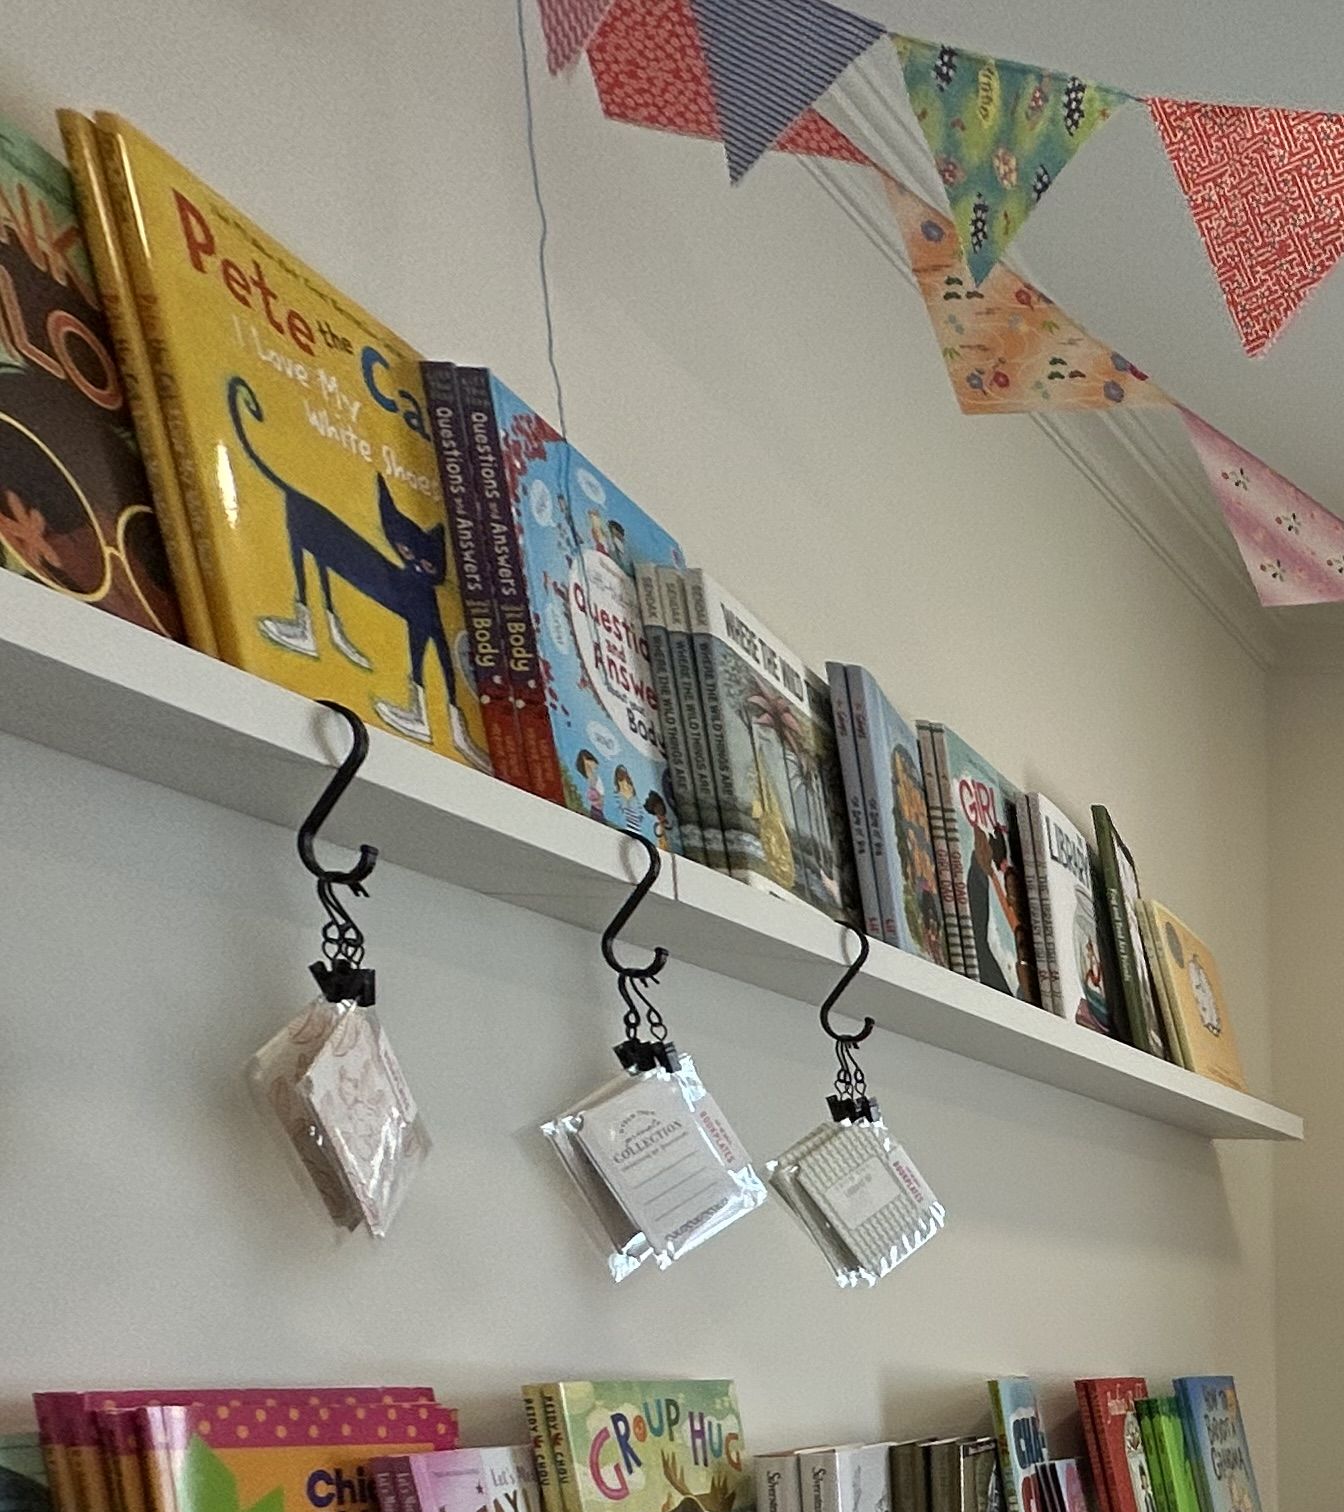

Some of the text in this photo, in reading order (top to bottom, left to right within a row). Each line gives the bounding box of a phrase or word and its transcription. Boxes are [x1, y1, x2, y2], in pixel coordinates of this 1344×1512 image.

[173, 187, 315, 357] Pete
[315, 318, 355, 356] the
[360, 346, 432, 442] Ca
[251, 327, 309, 388] Love
[303, 399, 373, 463] White
[436, 405, 465, 494] Questions
[454, 513, 482, 593] Answers
[469, 613, 500, 668] Body
[470, 409, 500, 499] Questions
[490, 518, 517, 597] Answers
[504, 619, 532, 672] Body
[574, 582, 650, 660] Questio
[593, 642, 660, 711] Answe
[658, 673, 672, 694] THE
[681, 679, 694, 700] THE
[704, 681, 718, 703] THE
[949, 850, 964, 877] GIRL
[613, 1120, 683, 1164] COLLECTION
[588, 1398, 743, 1501] GROUP HUG
